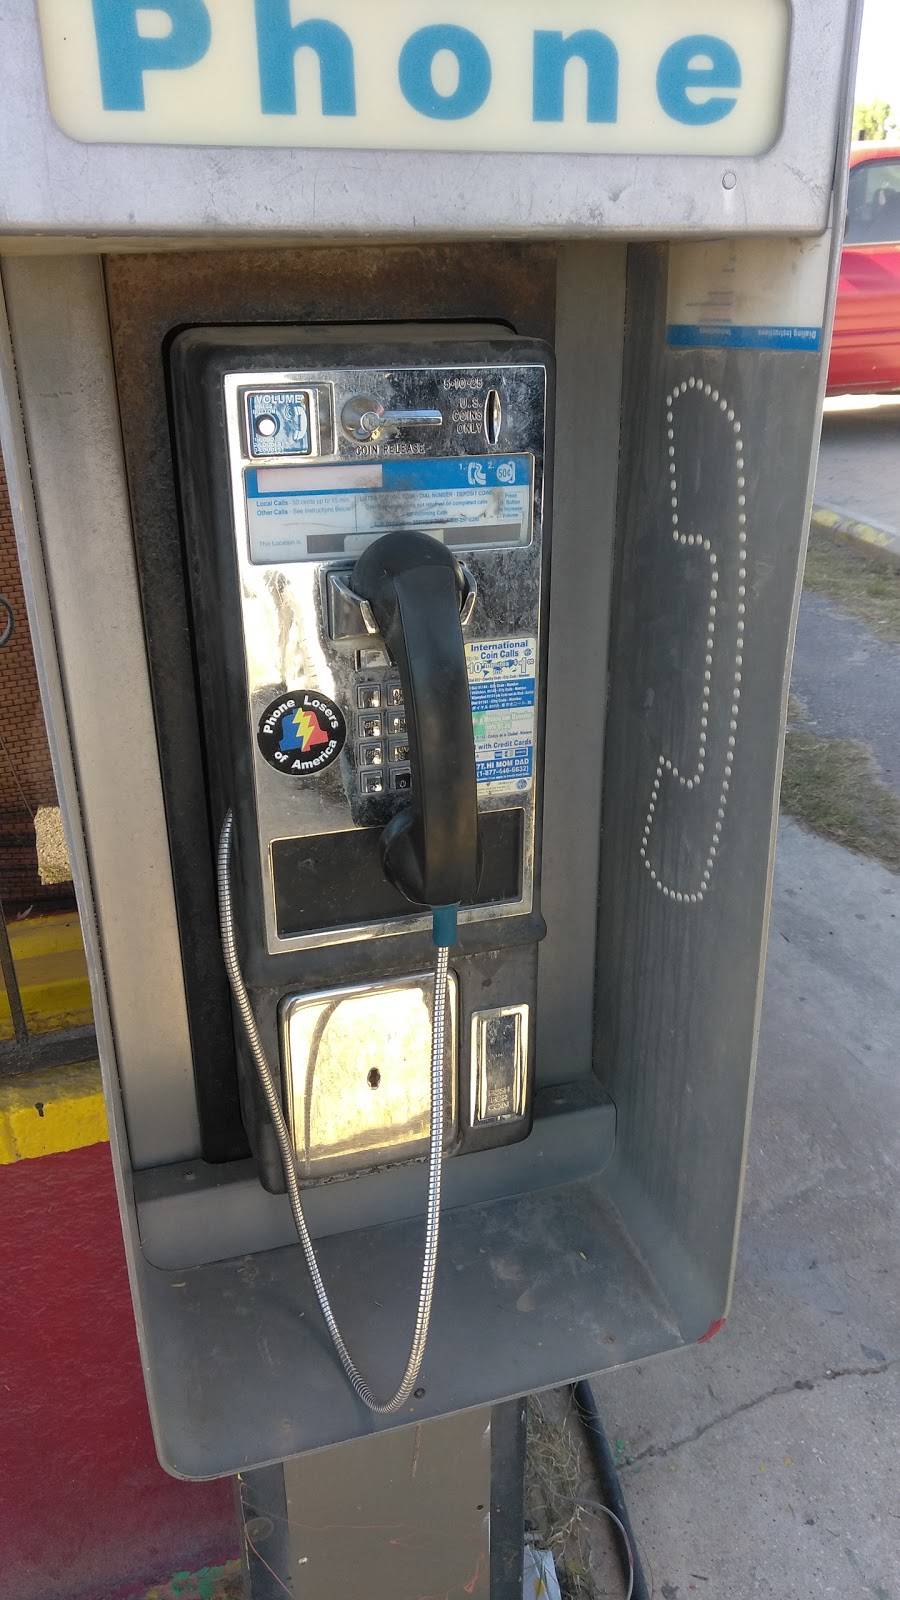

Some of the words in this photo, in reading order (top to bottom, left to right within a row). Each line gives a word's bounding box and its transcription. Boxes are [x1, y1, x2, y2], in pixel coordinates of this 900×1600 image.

[92, 0, 743, 126] Phone
[758, 328, 792, 337] Instructions
[793, 328, 816, 340] Dialing
[256, 395, 303, 404] VOLUME
[459, 398, 483, 409] U.S.
[452, 410, 483, 421] COINS
[457, 422, 482, 434] ONLY
[356, 445, 379, 456] COIN
[384, 443, 425, 455] RELEASE
[471, 640, 528, 652] International
[481, 651, 498, 660] Coin
[500, 649, 519, 658] Calls
[263, 699, 296, 734] Phone
[303, 695, 339, 729] Losers
[493, 741, 512, 749] Credit
[514, 738, 532, 746] Cards
[274, 751, 289, 763] of
[291, 739, 338, 769] America
[496, 760, 513, 769] MOM
[514, 758, 529, 766] DAD
